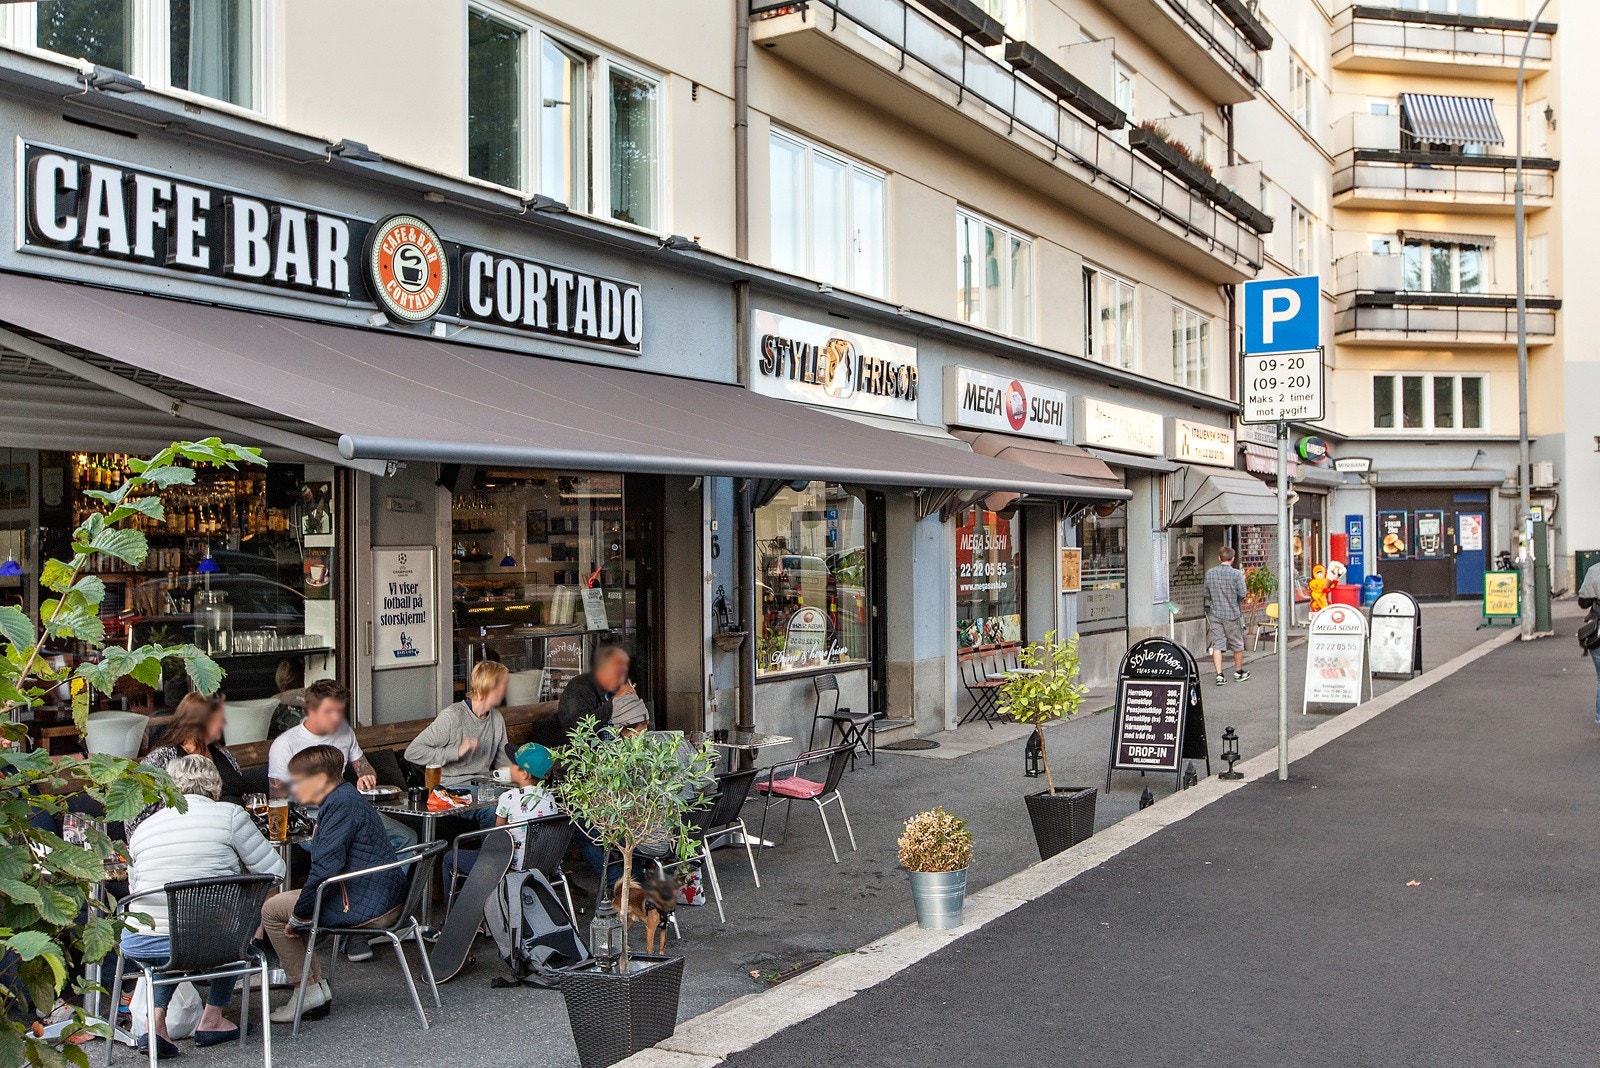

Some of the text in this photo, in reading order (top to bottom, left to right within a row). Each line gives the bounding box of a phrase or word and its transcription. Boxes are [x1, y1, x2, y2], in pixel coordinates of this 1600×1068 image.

[34, 154, 644, 346] CAFE BAR CORTADO
[386, 280, 435, 309] CORTADO
[1262, 287, 1301, 344] P
[759, 334, 828, 385] STYLE
[963, 383, 1003, 416] MEGA
[1029, 396, 1064, 427] SUSHI
[1249, 392, 1315, 404] Maks 2 timer
[1256, 405, 1308, 417] mot avgift
[1217, 432, 1230, 444] PIZZA
[711, 535, 720, 559] 6
[960, 534, 1007, 550] MEGA SUSHI
[960, 562, 1007, 577] 22 22 05 55
[389, 582, 418, 595] Vi viser
[960, 580, 1008, 592] www.megasushi.no
[384, 594, 423, 610] fotball på
[380, 611, 426, 626] storskjerm!
[1130, 649, 1156, 668] Style
[1128, 746, 1167, 758] DROP-IN
